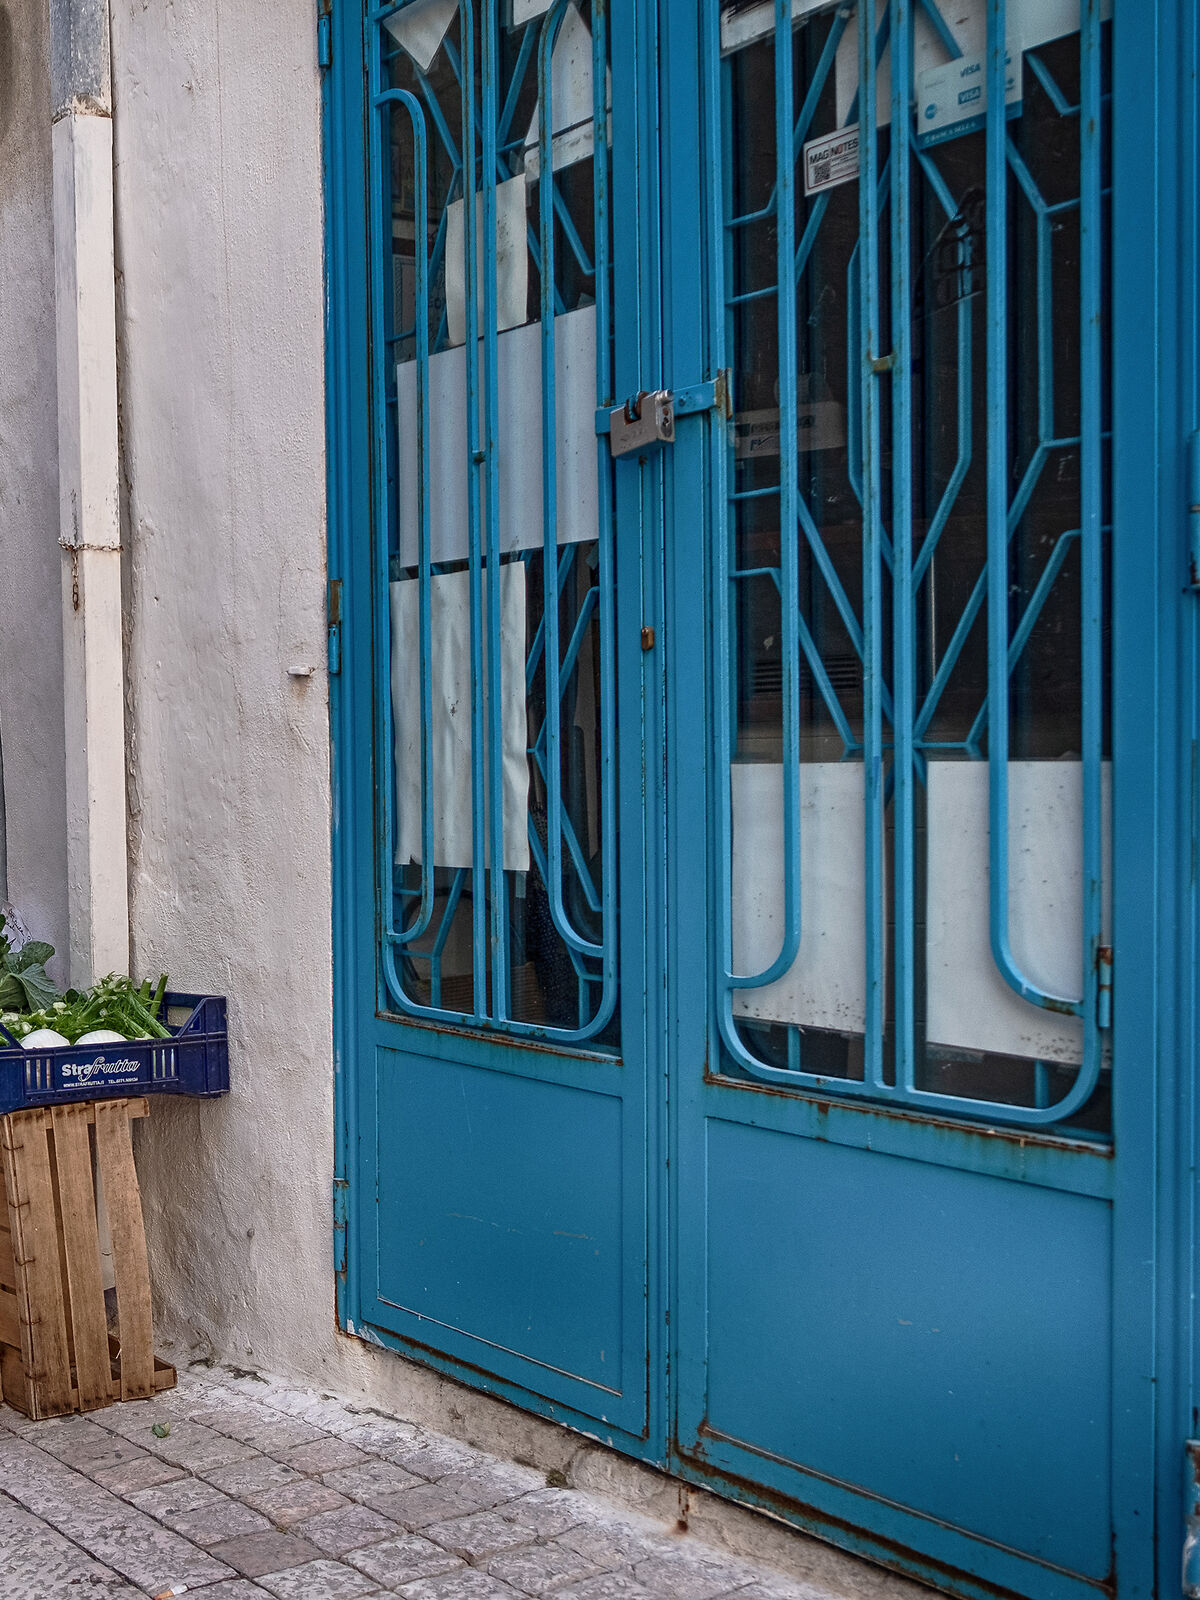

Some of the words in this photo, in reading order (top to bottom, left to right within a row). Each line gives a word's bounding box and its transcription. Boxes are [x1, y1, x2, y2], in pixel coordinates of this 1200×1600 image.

[960, 63, 981, 77] VISA
[961, 88, 980, 103] VISA
[61, 1056, 141, 1082] Strafrutta
